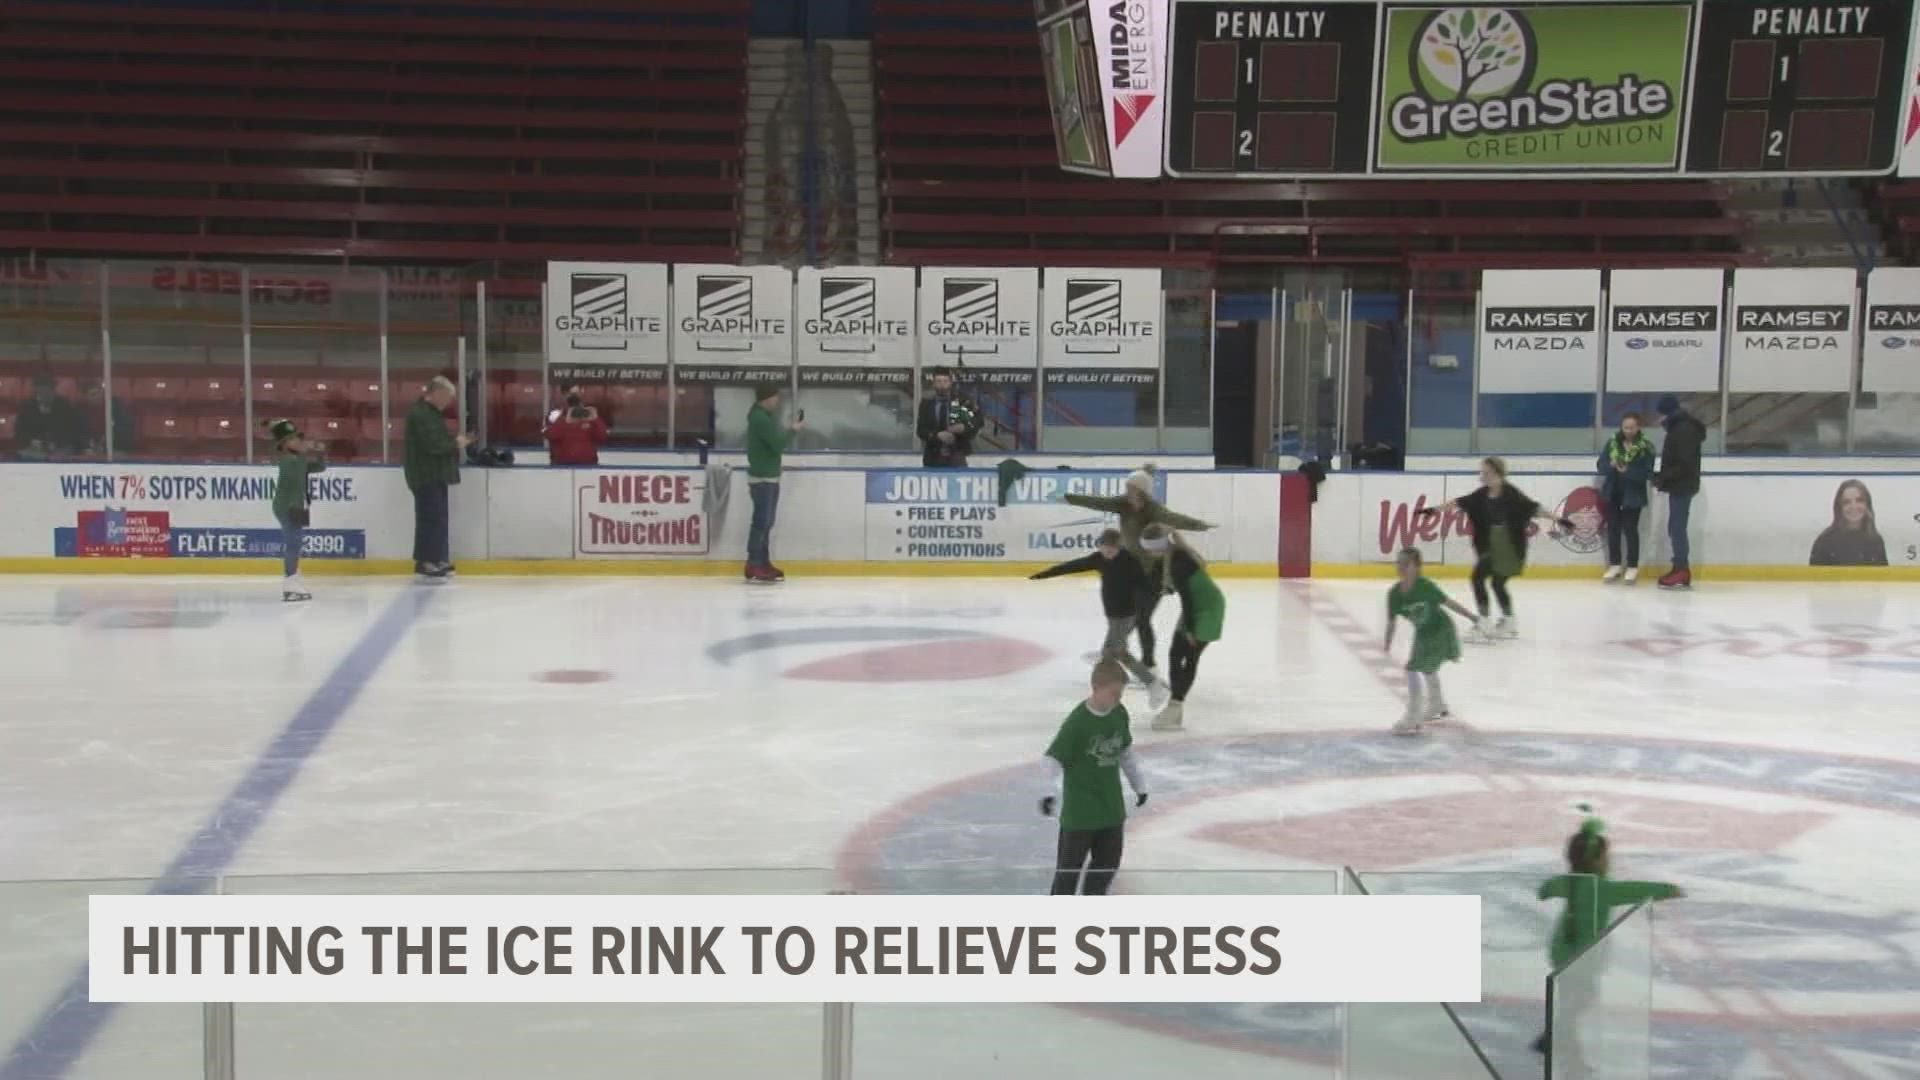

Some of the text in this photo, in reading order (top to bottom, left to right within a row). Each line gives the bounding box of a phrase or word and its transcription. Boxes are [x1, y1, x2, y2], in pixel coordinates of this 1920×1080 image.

[1215, 11, 1326, 38] PENALTY
[1752, 6, 1871, 35] PENALTY
[1128, 0, 1149, 90] ENERG
[1244, 58, 1254, 84] 1
[1779, 57, 1789, 82] 1
[1391, 75, 1667, 140] GreenState
[1239, 130, 1254, 156] 2
[1465, 123, 1665, 160] CREDIT UNION
[1767, 130, 1783, 157] 2
[555, 315, 661, 332] GRAPHITE
[681, 318, 785, 335] GRAPHITE
[1490, 312, 1589, 327] RAMSEY
[1618, 312, 1710, 326] RAMSEY
[1741, 311, 1843, 326] RAMSEY
[805, 319, 908, 336] GRAPHITE
[928, 320, 1033, 336] GRAPHITE
[1050, 320, 1154, 337] GRAPHITE
[1494, 337, 1585, 350] MAZDA
[1745, 336, 1838, 350] MAZDA
[553, 368, 662, 379] WE BUILD IT BETTER!
[679, 370, 787, 381] WE BUILD IT BETTER!
[802, 372, 910, 383] WE BUILD IT BETTER!
[1047, 373, 1154, 384] WE BUILD IT BETTER!
[61, 475, 358, 501] WHEN 7% SOTPS MKANIN ENSE.
[598, 475, 691, 504] NIECE
[885, 476, 948, 501] JOIN
[1014, 476, 1057, 501] VIP
[908, 507, 996, 521] FREE PLAYS
[588, 511, 700, 545] TRUCKING
[908, 525, 983, 539] CONTESTS
[178, 534, 216, 553] FLAT
[219, 534, 246, 553] FEE
[908, 544, 1005, 558] PROMOTIONS
